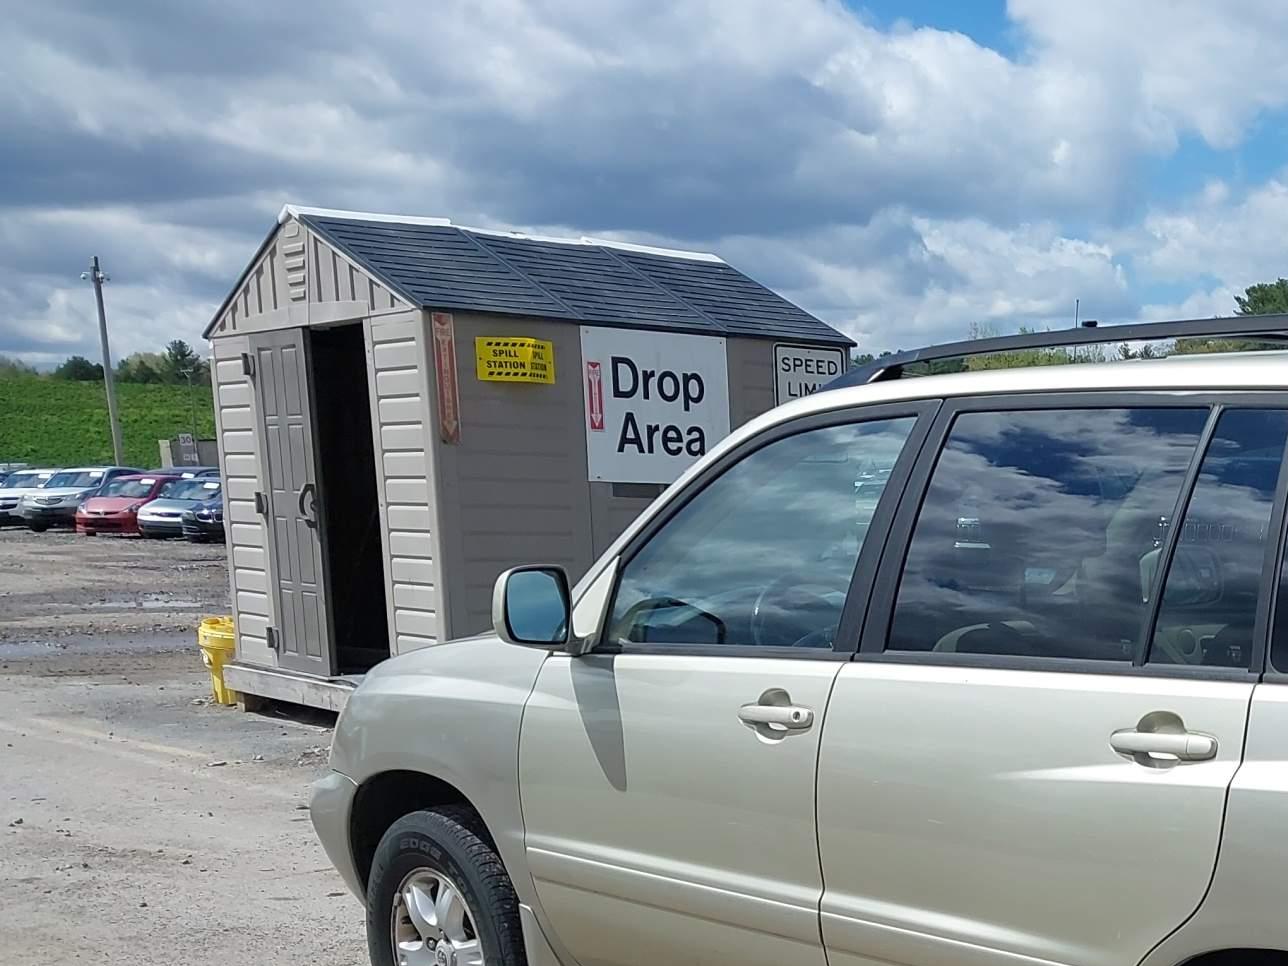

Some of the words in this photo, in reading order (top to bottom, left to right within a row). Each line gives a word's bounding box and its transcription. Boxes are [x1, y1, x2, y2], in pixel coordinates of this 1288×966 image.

[492, 349, 519, 358] SPILL
[487, 361, 526, 369] STATION
[781, 357, 838, 375] SPEED
[611, 356, 705, 411] Drop
[788, 381, 822, 397] LIM
[617, 411, 705, 456] Area
